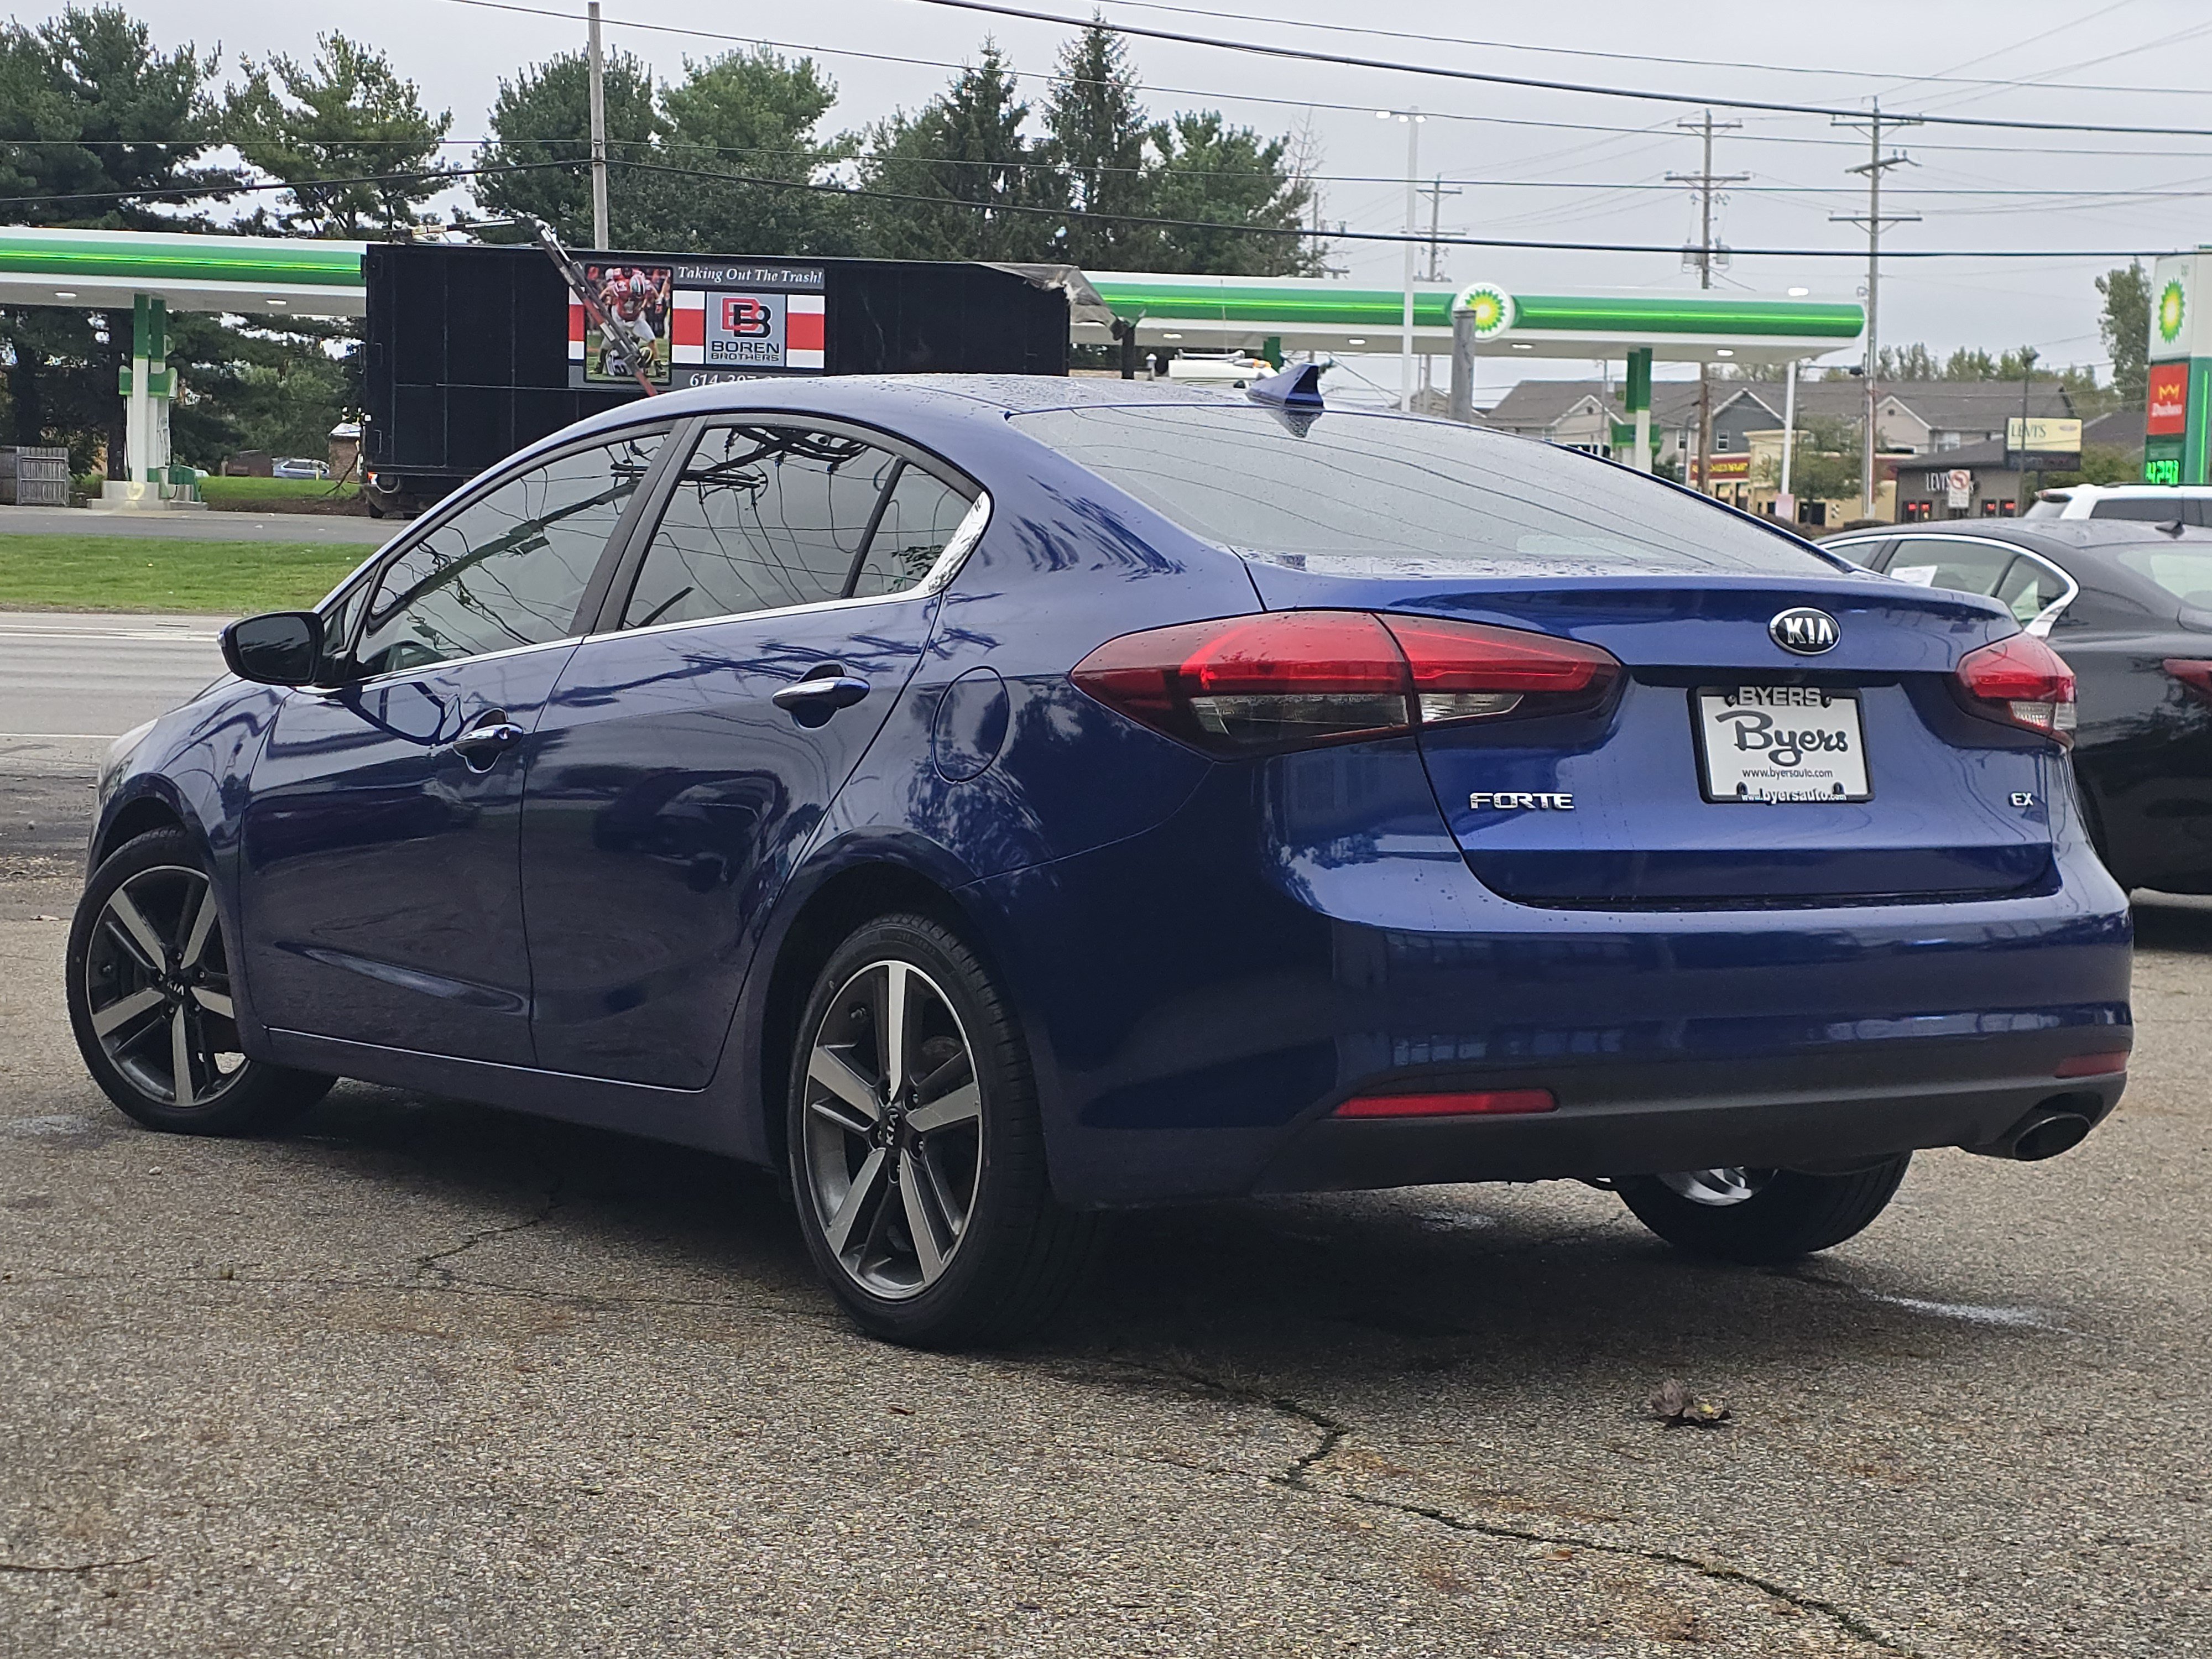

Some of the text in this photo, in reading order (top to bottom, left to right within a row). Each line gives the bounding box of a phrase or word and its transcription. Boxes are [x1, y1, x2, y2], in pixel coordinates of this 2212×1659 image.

[679, 267, 822, 284] Taking Out The Trash!
[711, 341, 780, 354] BOREN
[711, 352, 780, 361] BROTHERS
[1784, 618, 1834, 644] KIA
[1739, 687, 1820, 706] BYERS
[1715, 710, 1848, 767] Byers
[1742, 766, 1833, 780] www.byersauto.com
[1470, 792, 1574, 809] FORTE
[2011, 792, 2034, 806] EX
[886, 1114, 899, 1146] KIA
